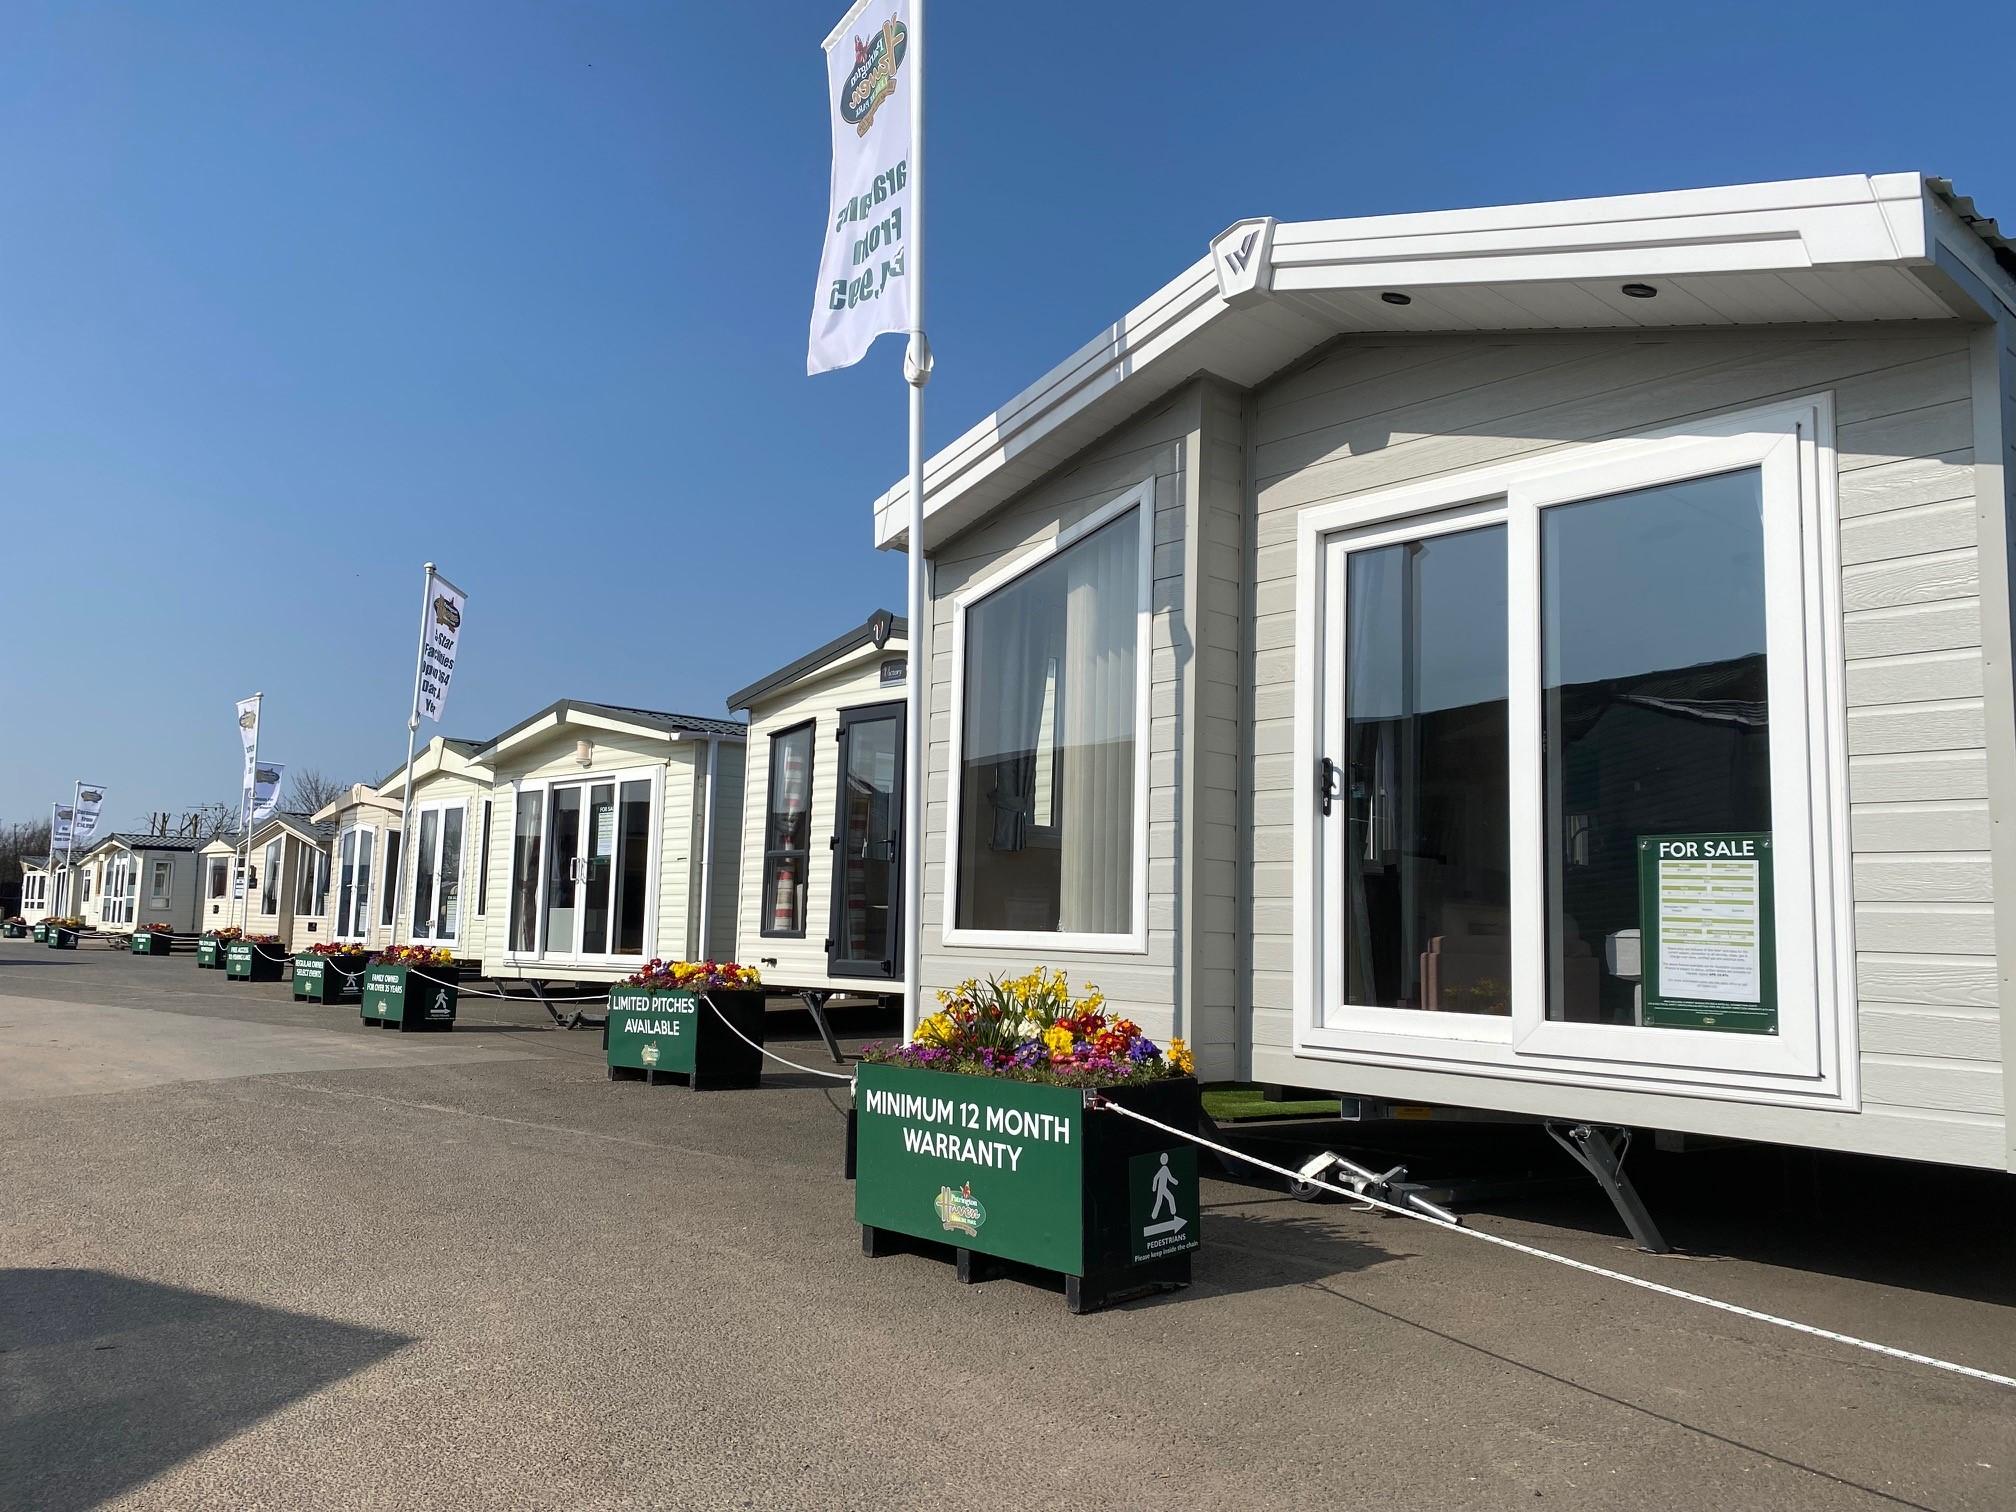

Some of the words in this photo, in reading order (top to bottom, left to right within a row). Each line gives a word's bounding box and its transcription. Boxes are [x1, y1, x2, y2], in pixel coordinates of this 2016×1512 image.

[1659, 842, 1698, 858] FOR
[1703, 840, 1754, 857] SALE
[372, 973, 384, 982] FAMILY
[384, 974, 400, 983] OWNED
[366, 983, 374, 991] FOR
[374, 984, 384, 992] OVER
[390, 985, 403, 994] YEARS
[613, 996, 650, 1012] LIMITED
[652, 997, 695, 1014] PITCHES
[624, 1018, 680, 1036] AVAILABLE
[866, 1088, 954, 1126] MINIMUM
[959, 1102, 980, 1129] 12
[986, 1107, 1070, 1144] MONTH
[902, 1127, 1022, 1172] WARRANTY
[1146, 1232, 1187, 1250] PEDESTRIANS
[1134, 1254, 1150, 1262] Please
[1163, 1246, 1177, 1255] inside
[1186, 1240, 1199, 1249] chain
